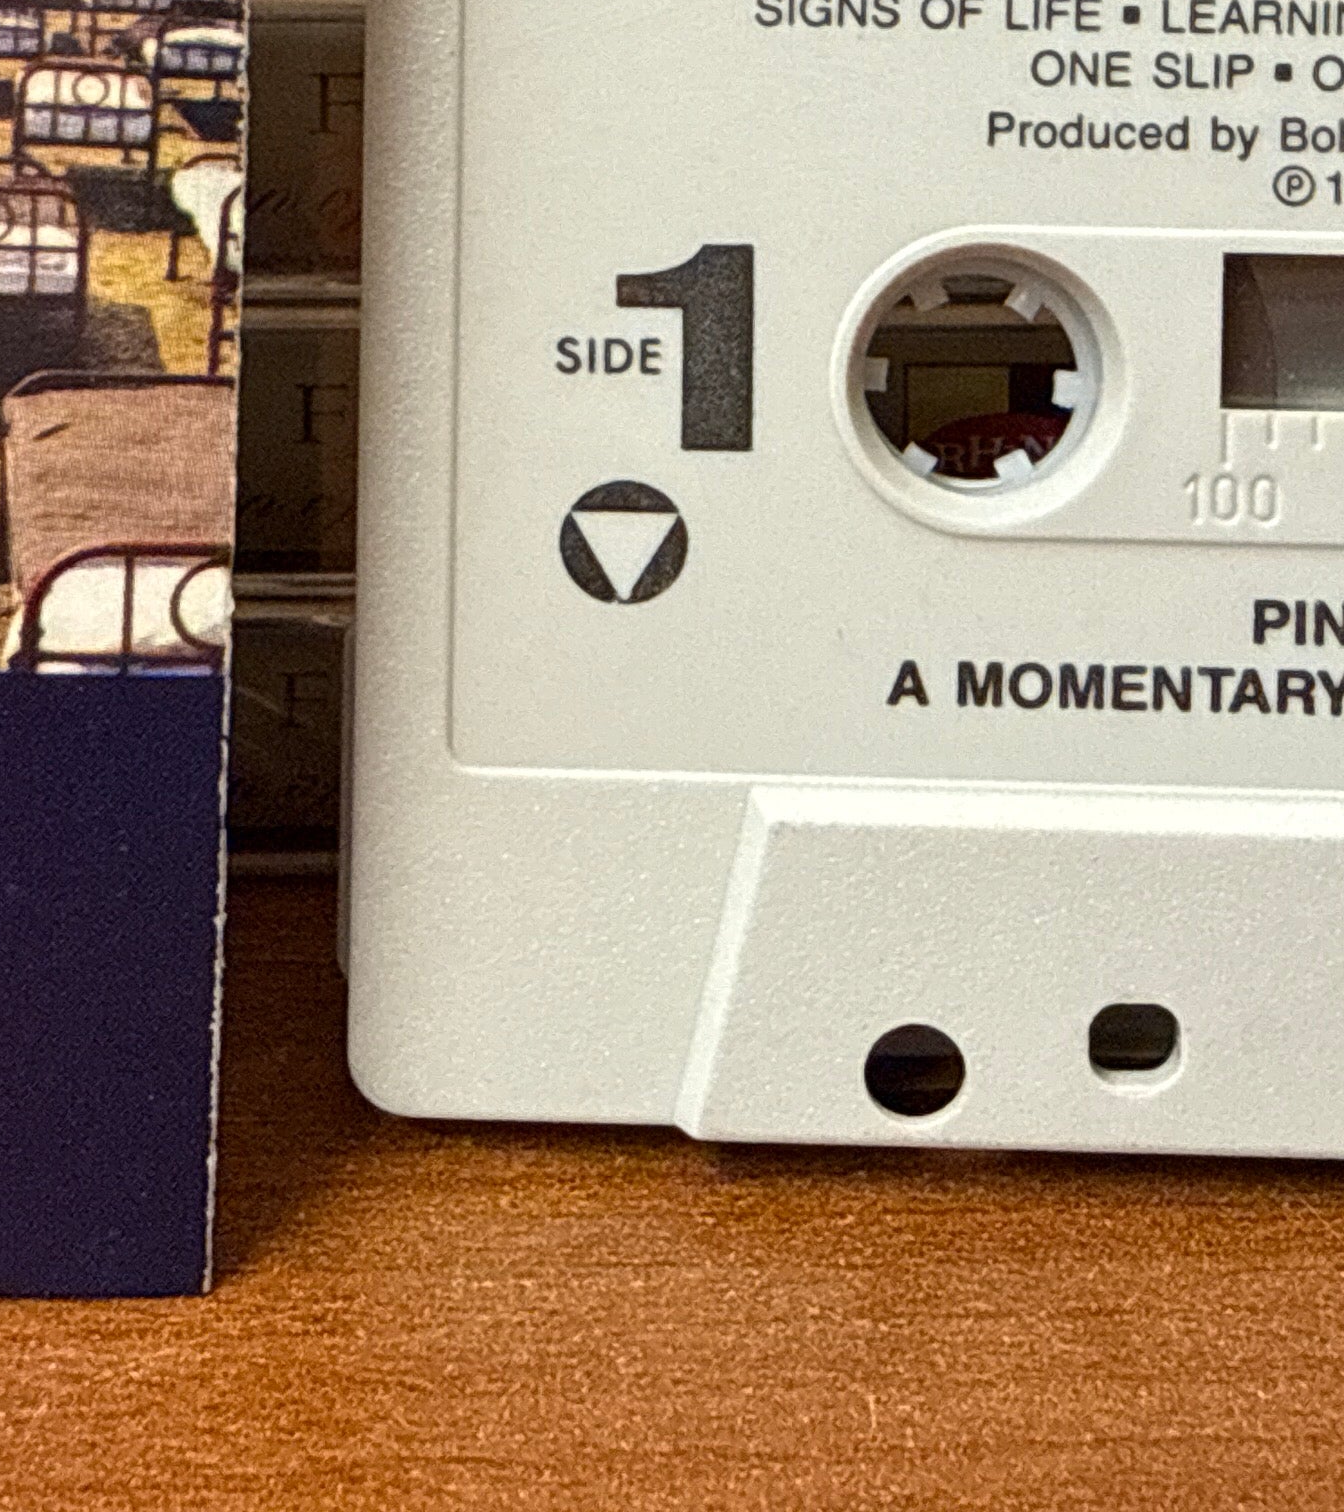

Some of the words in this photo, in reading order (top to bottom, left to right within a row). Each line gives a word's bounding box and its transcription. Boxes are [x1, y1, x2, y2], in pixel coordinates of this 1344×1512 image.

[1030, 49, 1132, 88] ONE
[1152, 51, 1255, 90] SLIP
[986, 110, 1190, 152] Produced
[1210, 115, 1260, 162] by
[555, 336, 661, 376] SIDE
[615, 243, 755, 452] 1
[1182, 471, 1283, 528] 100
[886, 660, 930, 707] A
